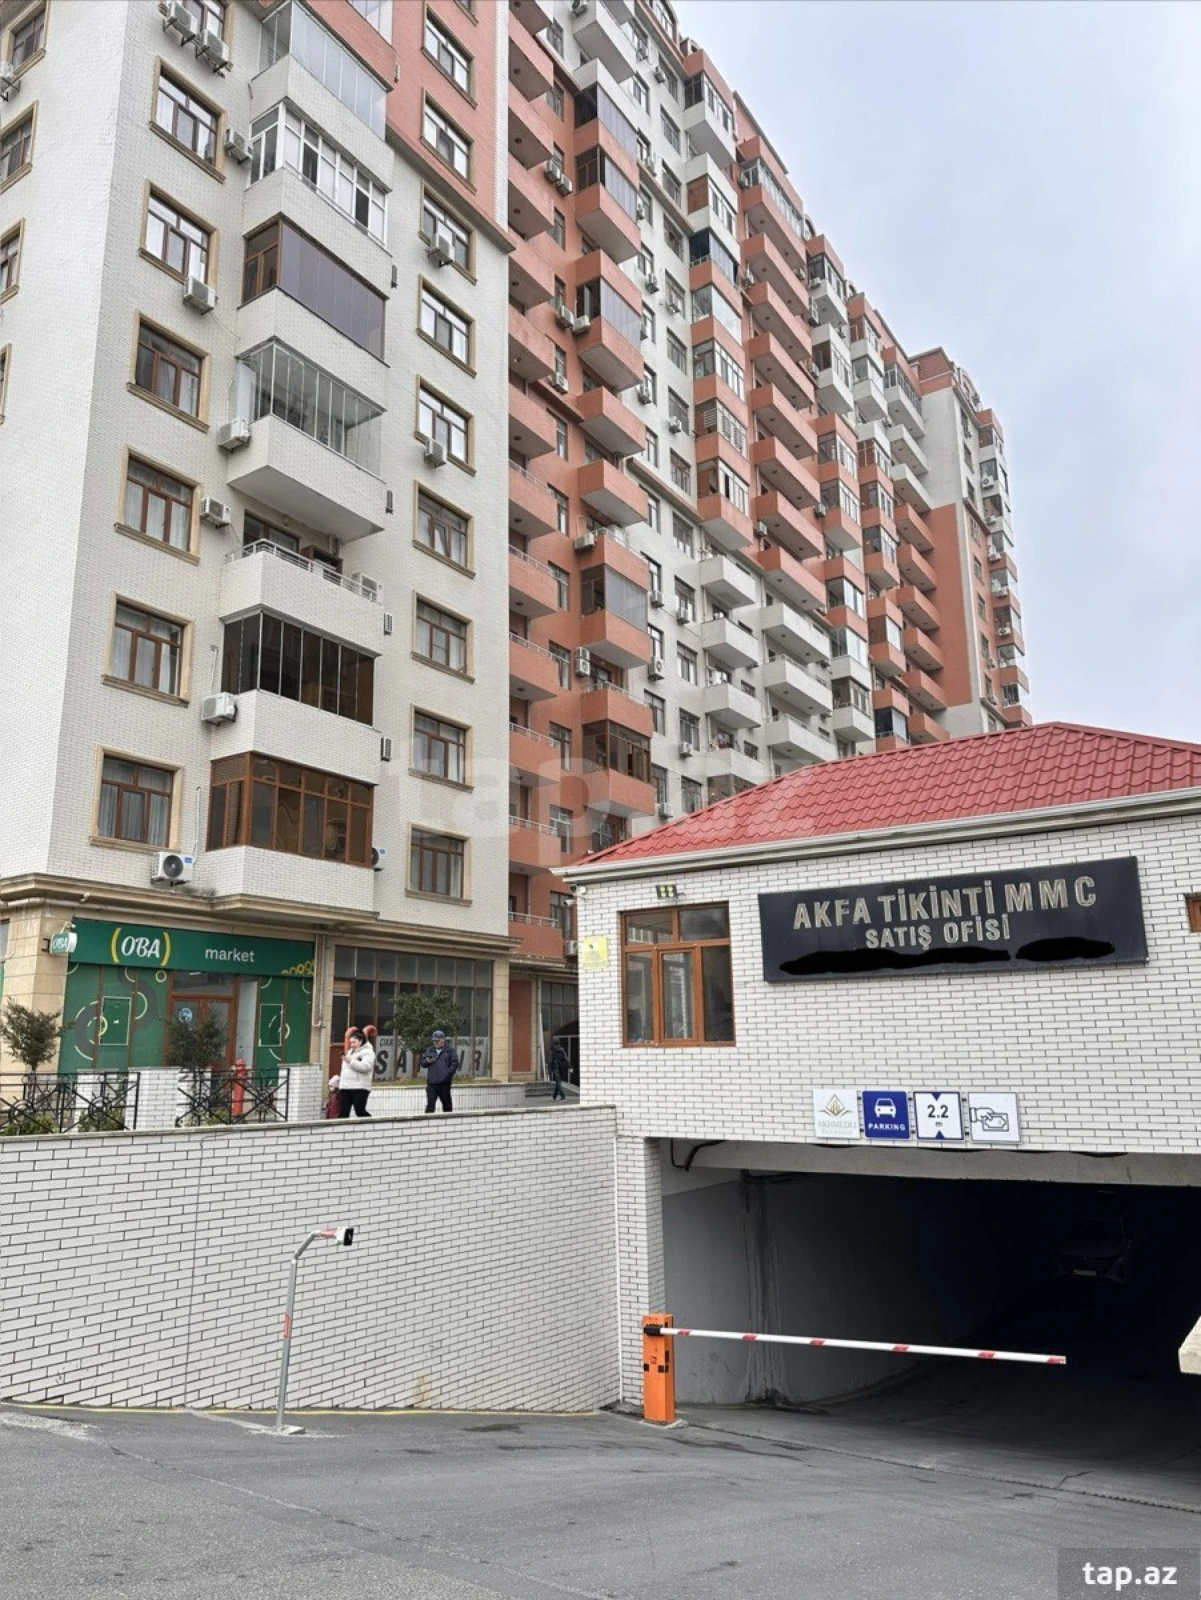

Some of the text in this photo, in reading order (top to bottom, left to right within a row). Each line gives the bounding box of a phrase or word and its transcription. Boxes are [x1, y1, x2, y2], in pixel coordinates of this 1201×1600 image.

[793, 875, 1097, 930] AKFA TİKİNTİ MMC
[865, 913, 1010, 950] SATIŞ OFİSİ
[204, 948, 255, 963] market
[927, 1104, 949, 1118] 2.2
[868, 1123, 906, 1131] PARKING
